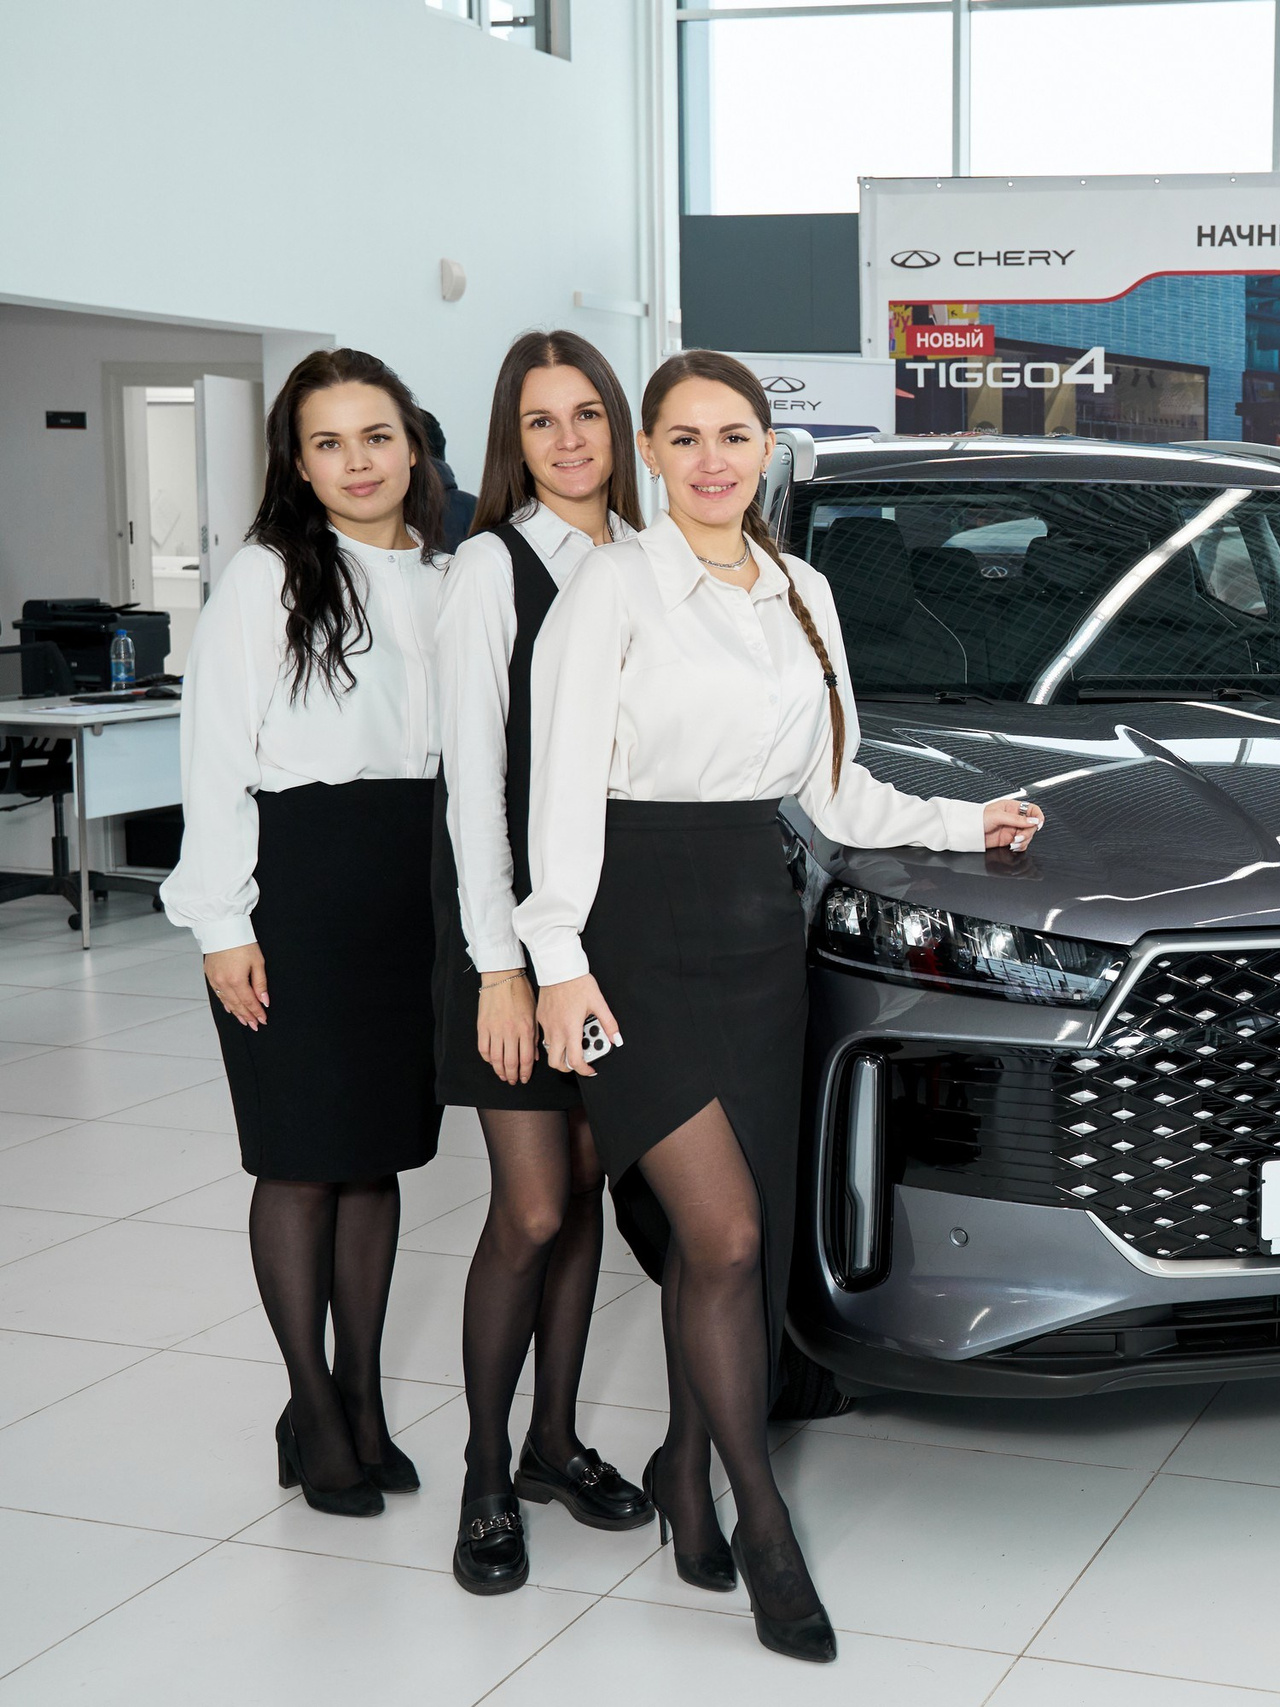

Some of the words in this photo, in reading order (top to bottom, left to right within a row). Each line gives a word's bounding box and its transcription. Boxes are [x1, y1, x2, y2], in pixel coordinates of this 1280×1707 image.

[953, 249, 1076, 267] CHERY
[916, 328, 984, 348] НОВЫЙ
[768, 399, 822, 411] ERY
